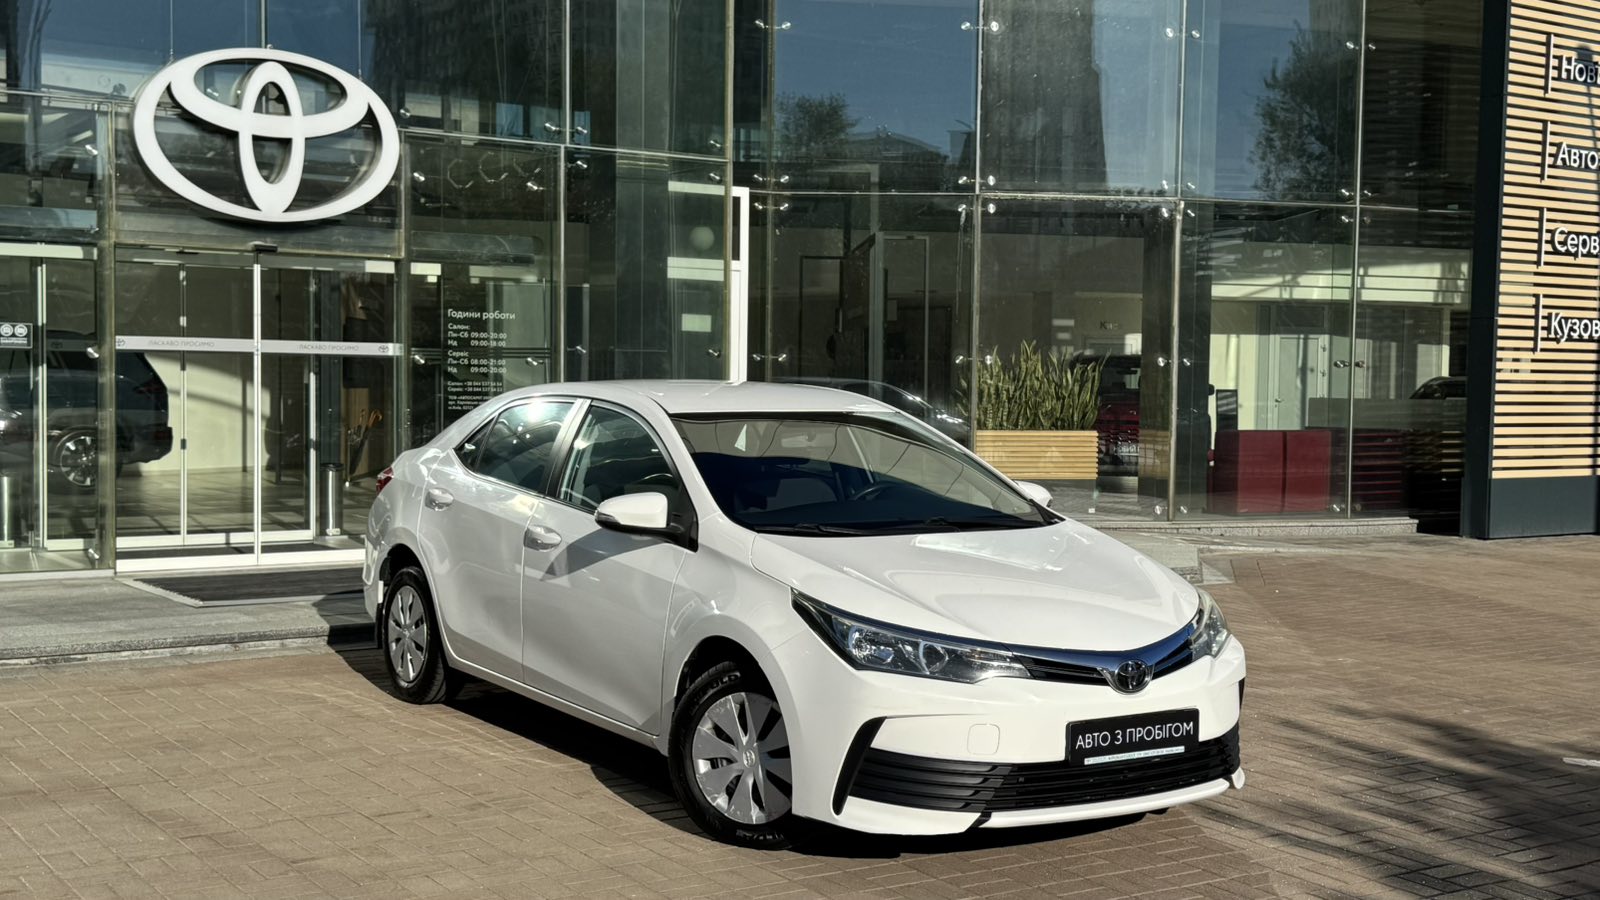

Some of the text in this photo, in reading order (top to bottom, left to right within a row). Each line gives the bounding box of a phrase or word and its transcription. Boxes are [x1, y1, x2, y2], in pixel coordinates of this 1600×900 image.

[1557, 142, 1599, 170] Авто
[447, 308, 516, 321] Години роботи
[1549, 312, 1600, 342] Кузов
[447, 339, 458, 347] Нд
[447, 366, 458, 374] Нд
[1075, 731, 1111, 750] АВТО
[1126, 721, 1194, 744] ПРОБІГОМ
